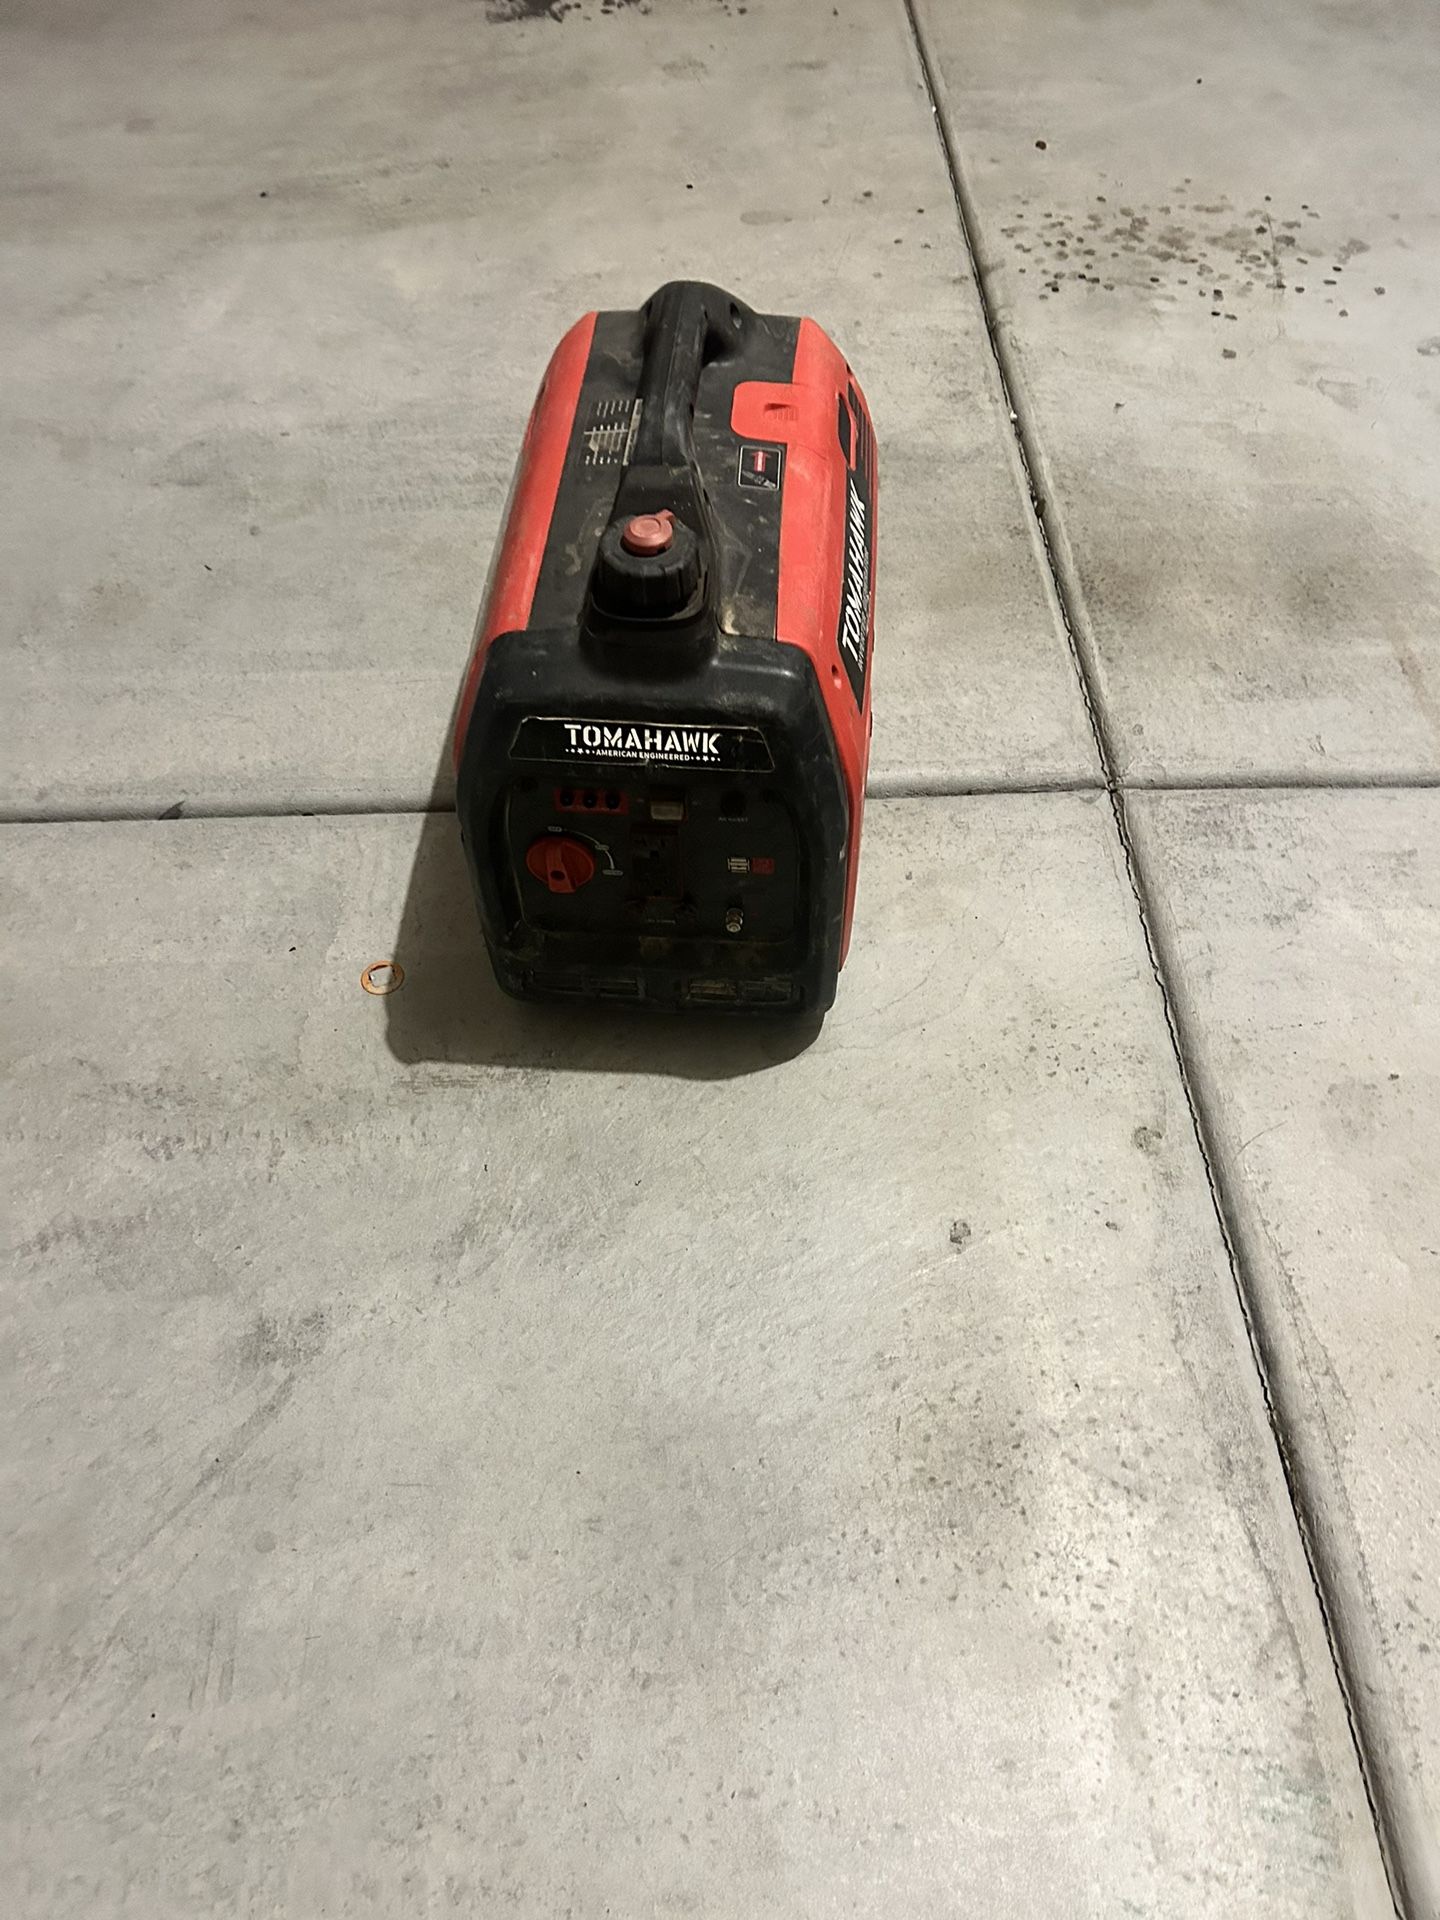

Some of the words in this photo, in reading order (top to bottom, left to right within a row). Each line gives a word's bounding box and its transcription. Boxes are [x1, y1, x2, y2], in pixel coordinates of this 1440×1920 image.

[842, 479, 865, 661] TOMAHAWK
[564, 724, 721, 754] TOMAHAWK
[596, 749, 637, 759] AMERICAN
[639, 752, 690, 761] ENGINEERED
